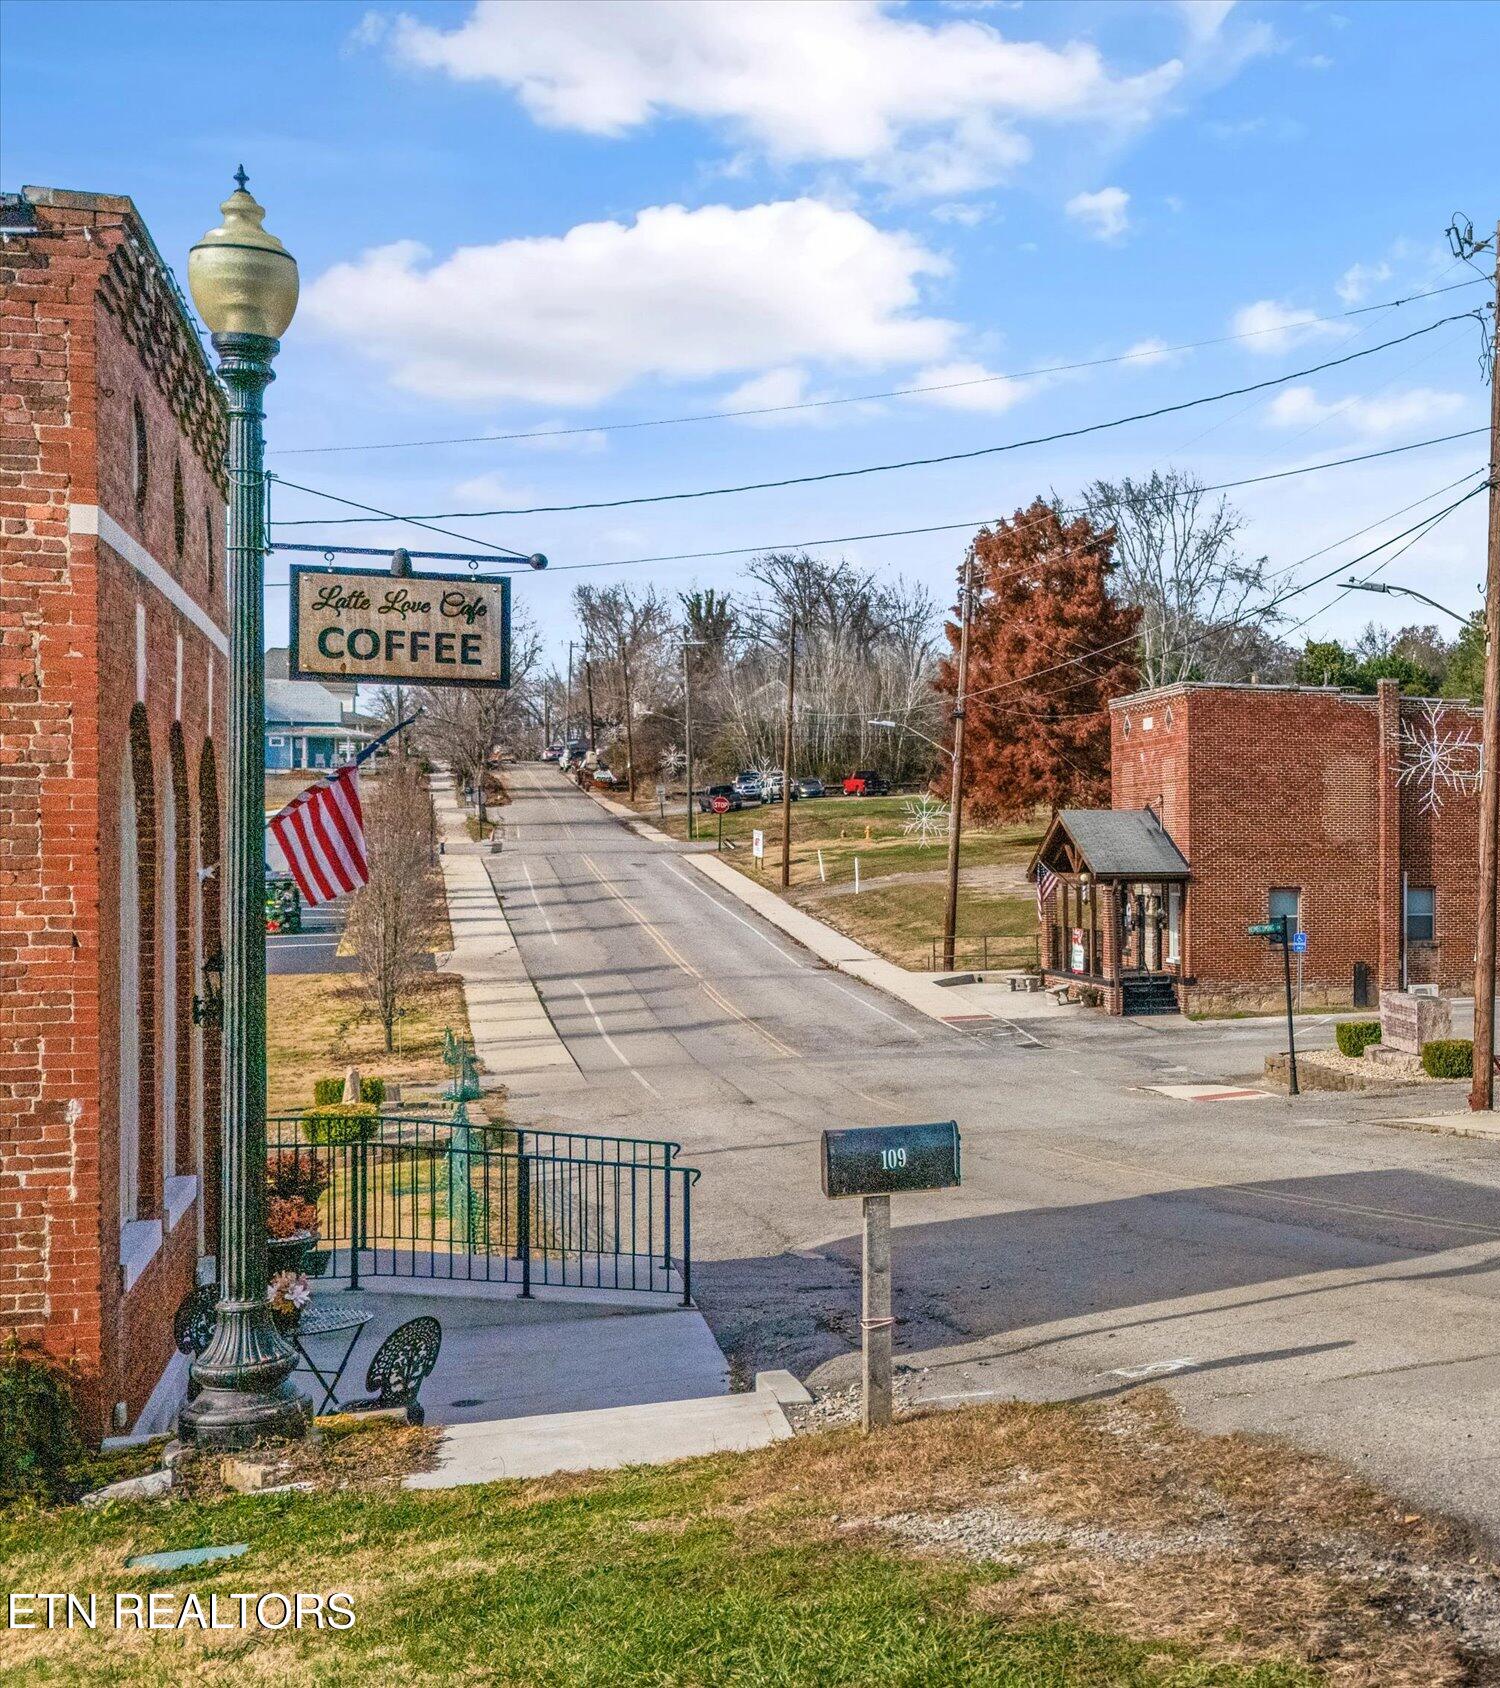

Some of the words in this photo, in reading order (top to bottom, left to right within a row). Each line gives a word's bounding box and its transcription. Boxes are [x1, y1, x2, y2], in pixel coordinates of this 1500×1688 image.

[311, 585, 371, 617] Latte
[378, 589, 431, 620] Love
[439, 590, 488, 625] Cafe
[317, 626, 483, 666] COFFEE
[881, 1148, 907, 1170] 109
